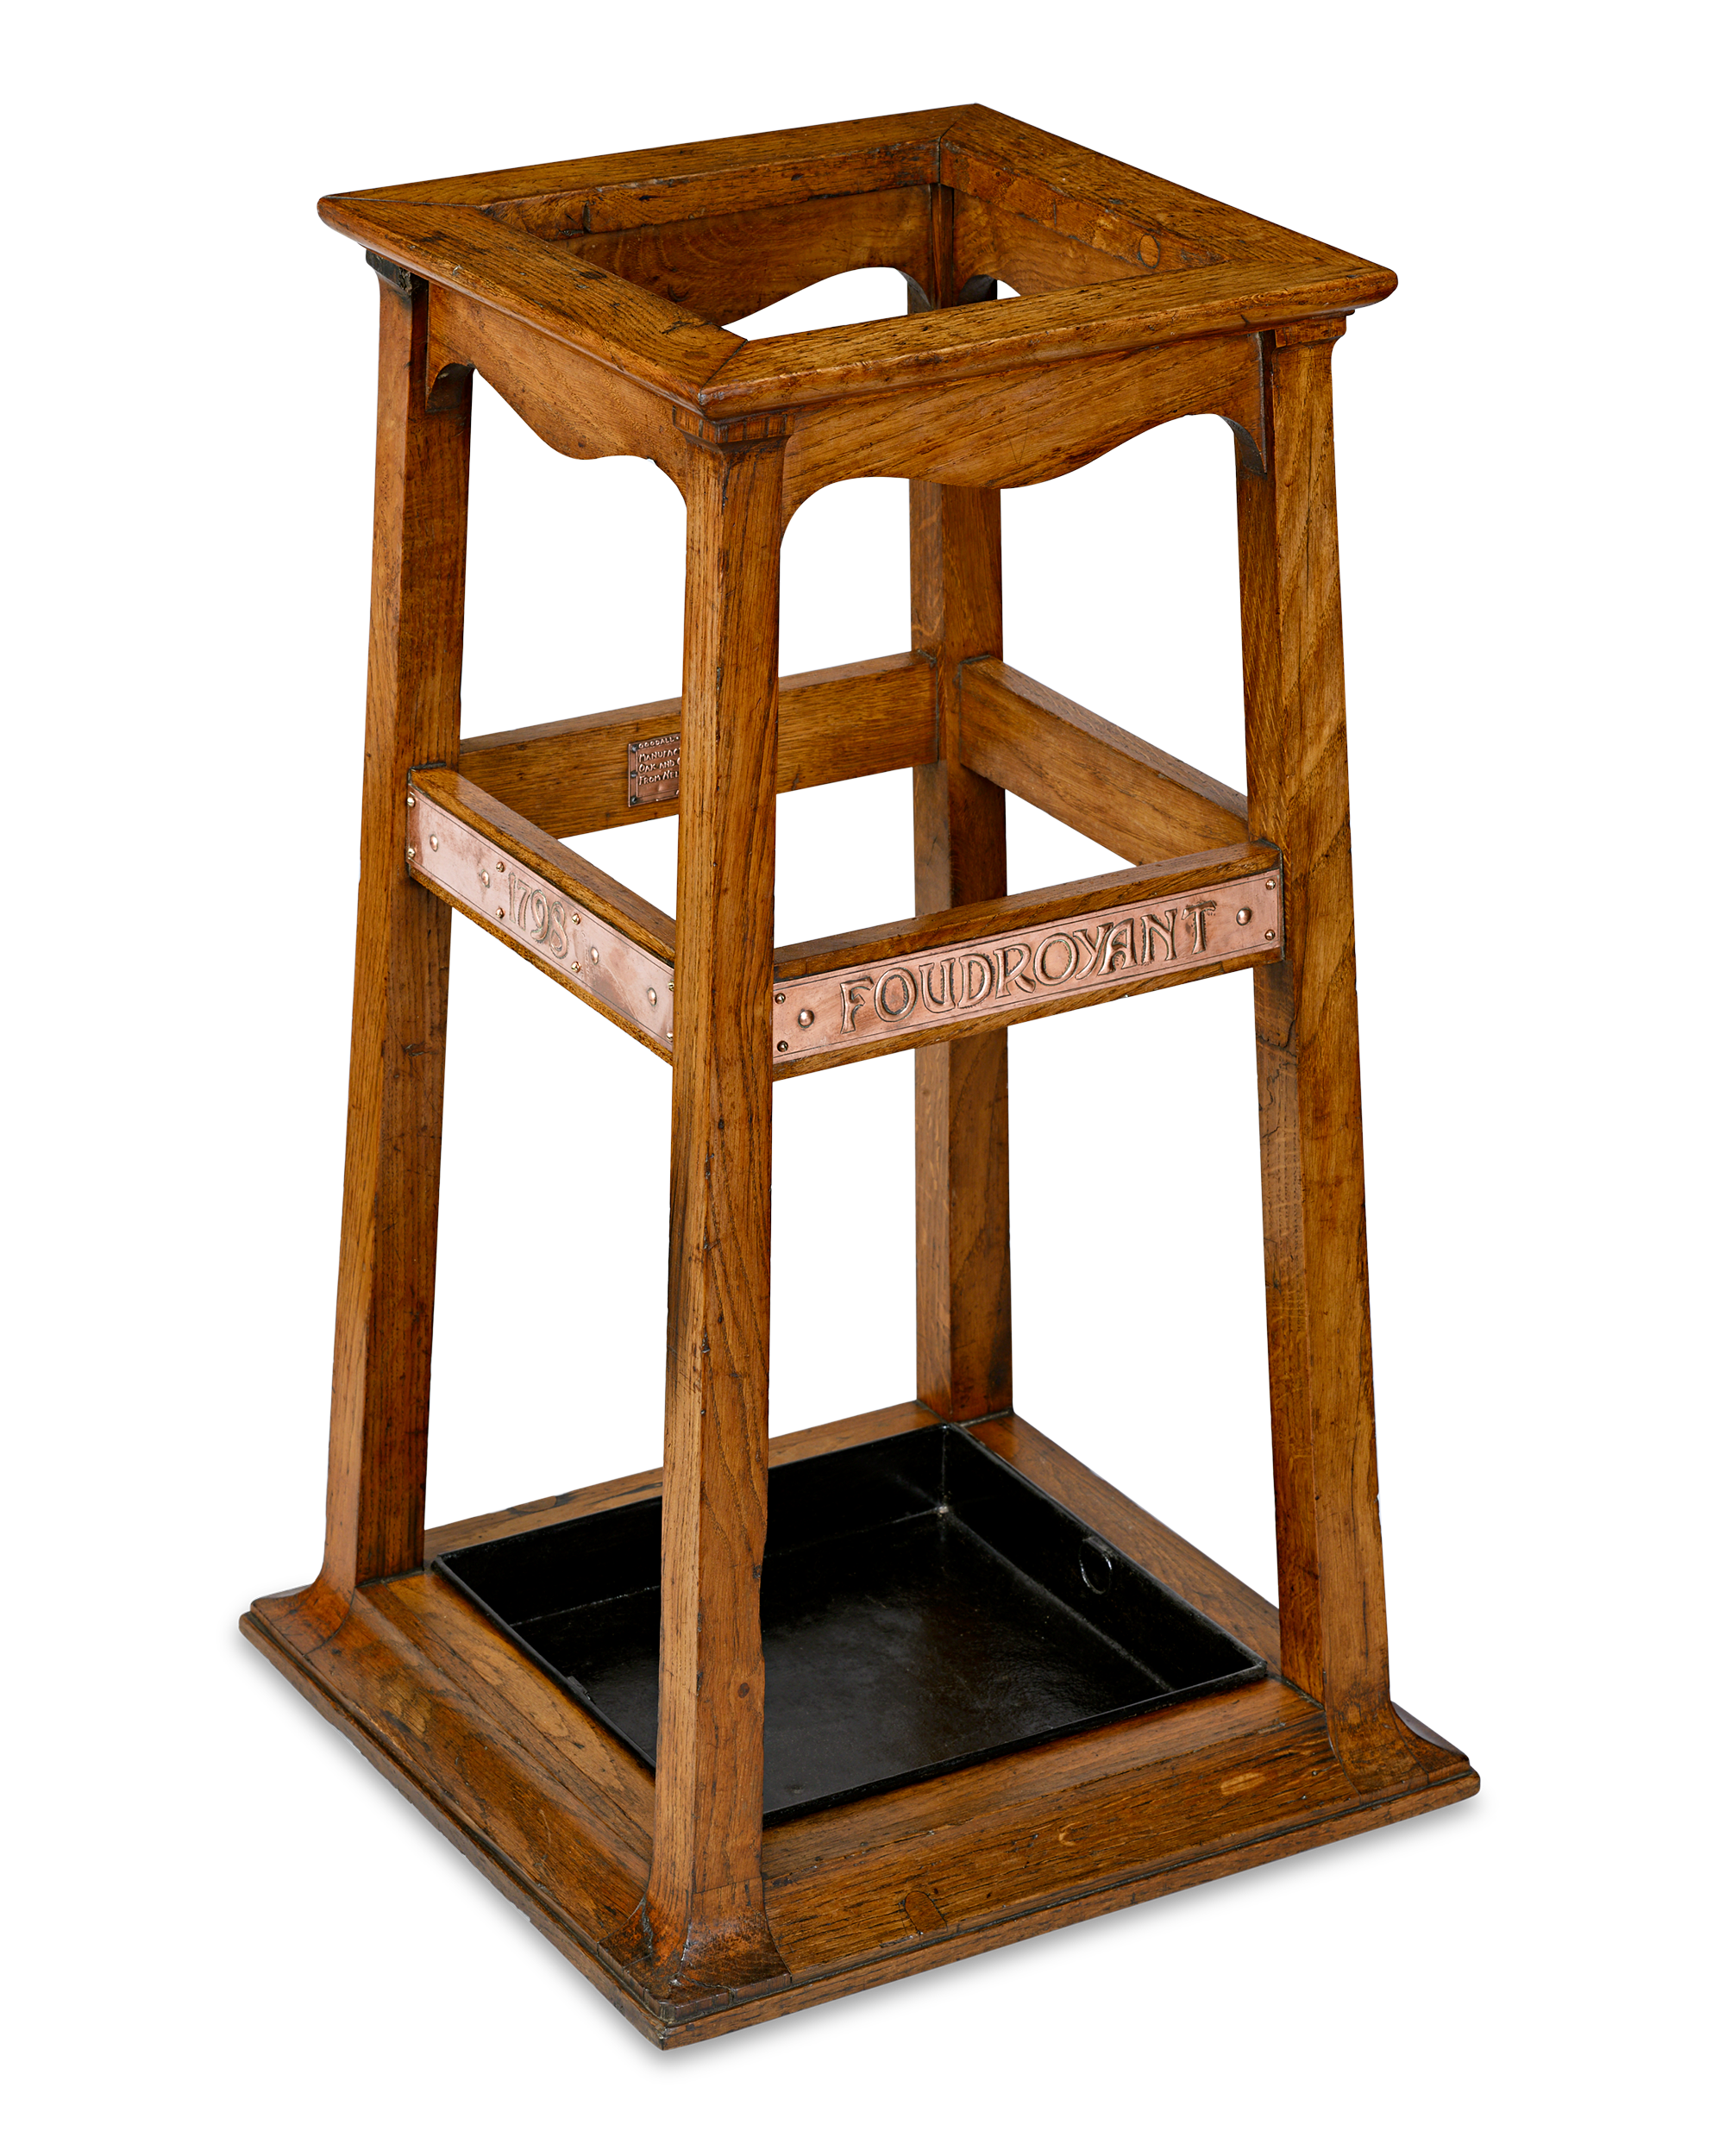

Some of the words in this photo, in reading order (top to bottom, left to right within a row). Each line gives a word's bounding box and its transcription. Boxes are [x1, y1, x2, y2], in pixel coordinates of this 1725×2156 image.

[639, 736, 674, 749] GOODALL
[639, 747, 681, 762] MANUFAC
[639, 763, 656, 773] OAK
[659, 760, 675, 769] AND
[639, 774, 661, 786] FROM
[508, 872, 569, 959] 1798
[839, 900, 1217, 1034] FOUDROYANT
